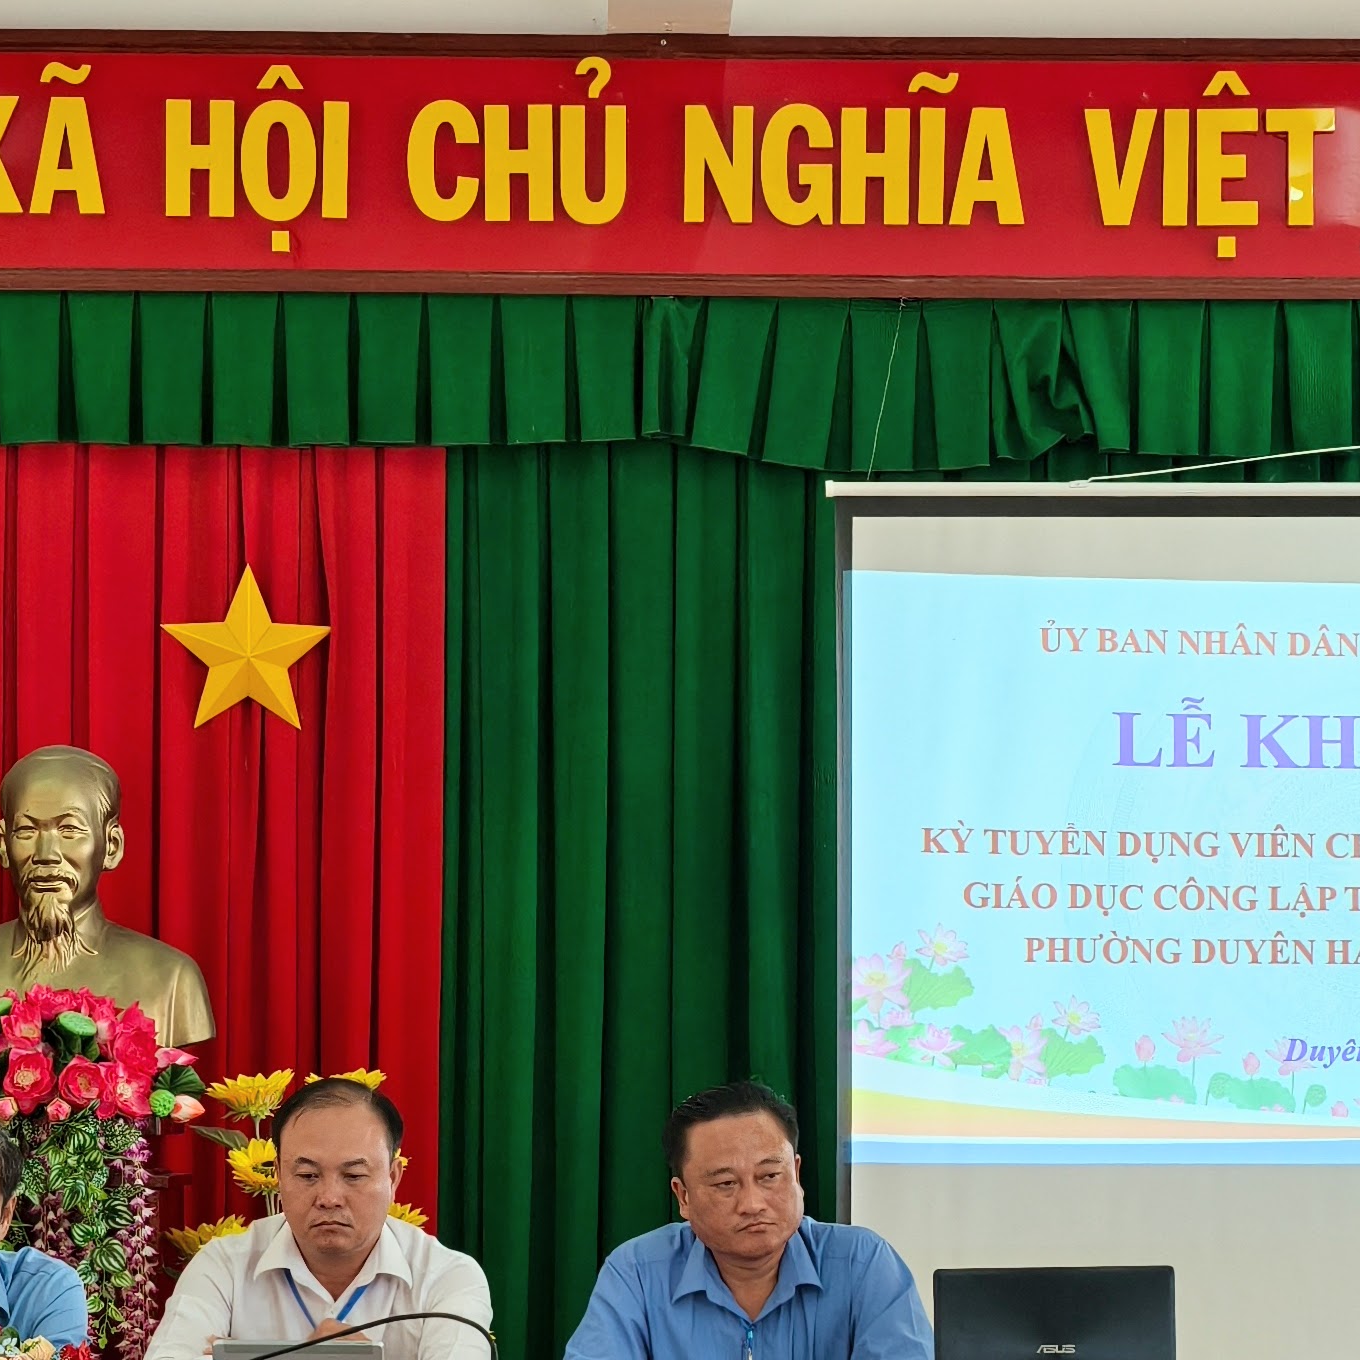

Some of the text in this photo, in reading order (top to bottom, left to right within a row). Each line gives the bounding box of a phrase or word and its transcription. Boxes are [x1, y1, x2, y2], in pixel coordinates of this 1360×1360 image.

[166, 65, 351, 252] HỘI
[407, 57, 626, 224] CHỦ
[684, 72, 1025, 226] NGHĨA
[1085, 71, 1335, 257] VIỆT
[1040, 620, 1088, 652] ỦY
[1096, 628, 1168, 654] BAN
[1178, 623, 1278, 655] NHÂN
[1287, 624, 1360, 657] DÂN
[1112, 697, 1215, 768] LỄ
[921, 820, 974, 853] KỲ
[1116, 831, 1220, 864] DỤNG
[1228, 824, 1316, 858] VIÊN
[964, 876, 1057, 909] GIÁO
[1067, 884, 1143, 916] DỤC
[1154, 876, 1258, 911] CÔNG
[1268, 882, 1337, 918] LẬP
[1024, 931, 1182, 964] PHƯỜNG
[1192, 931, 1316, 965] DUYÊN
[1036, 1344, 1076, 1354] ASUS
